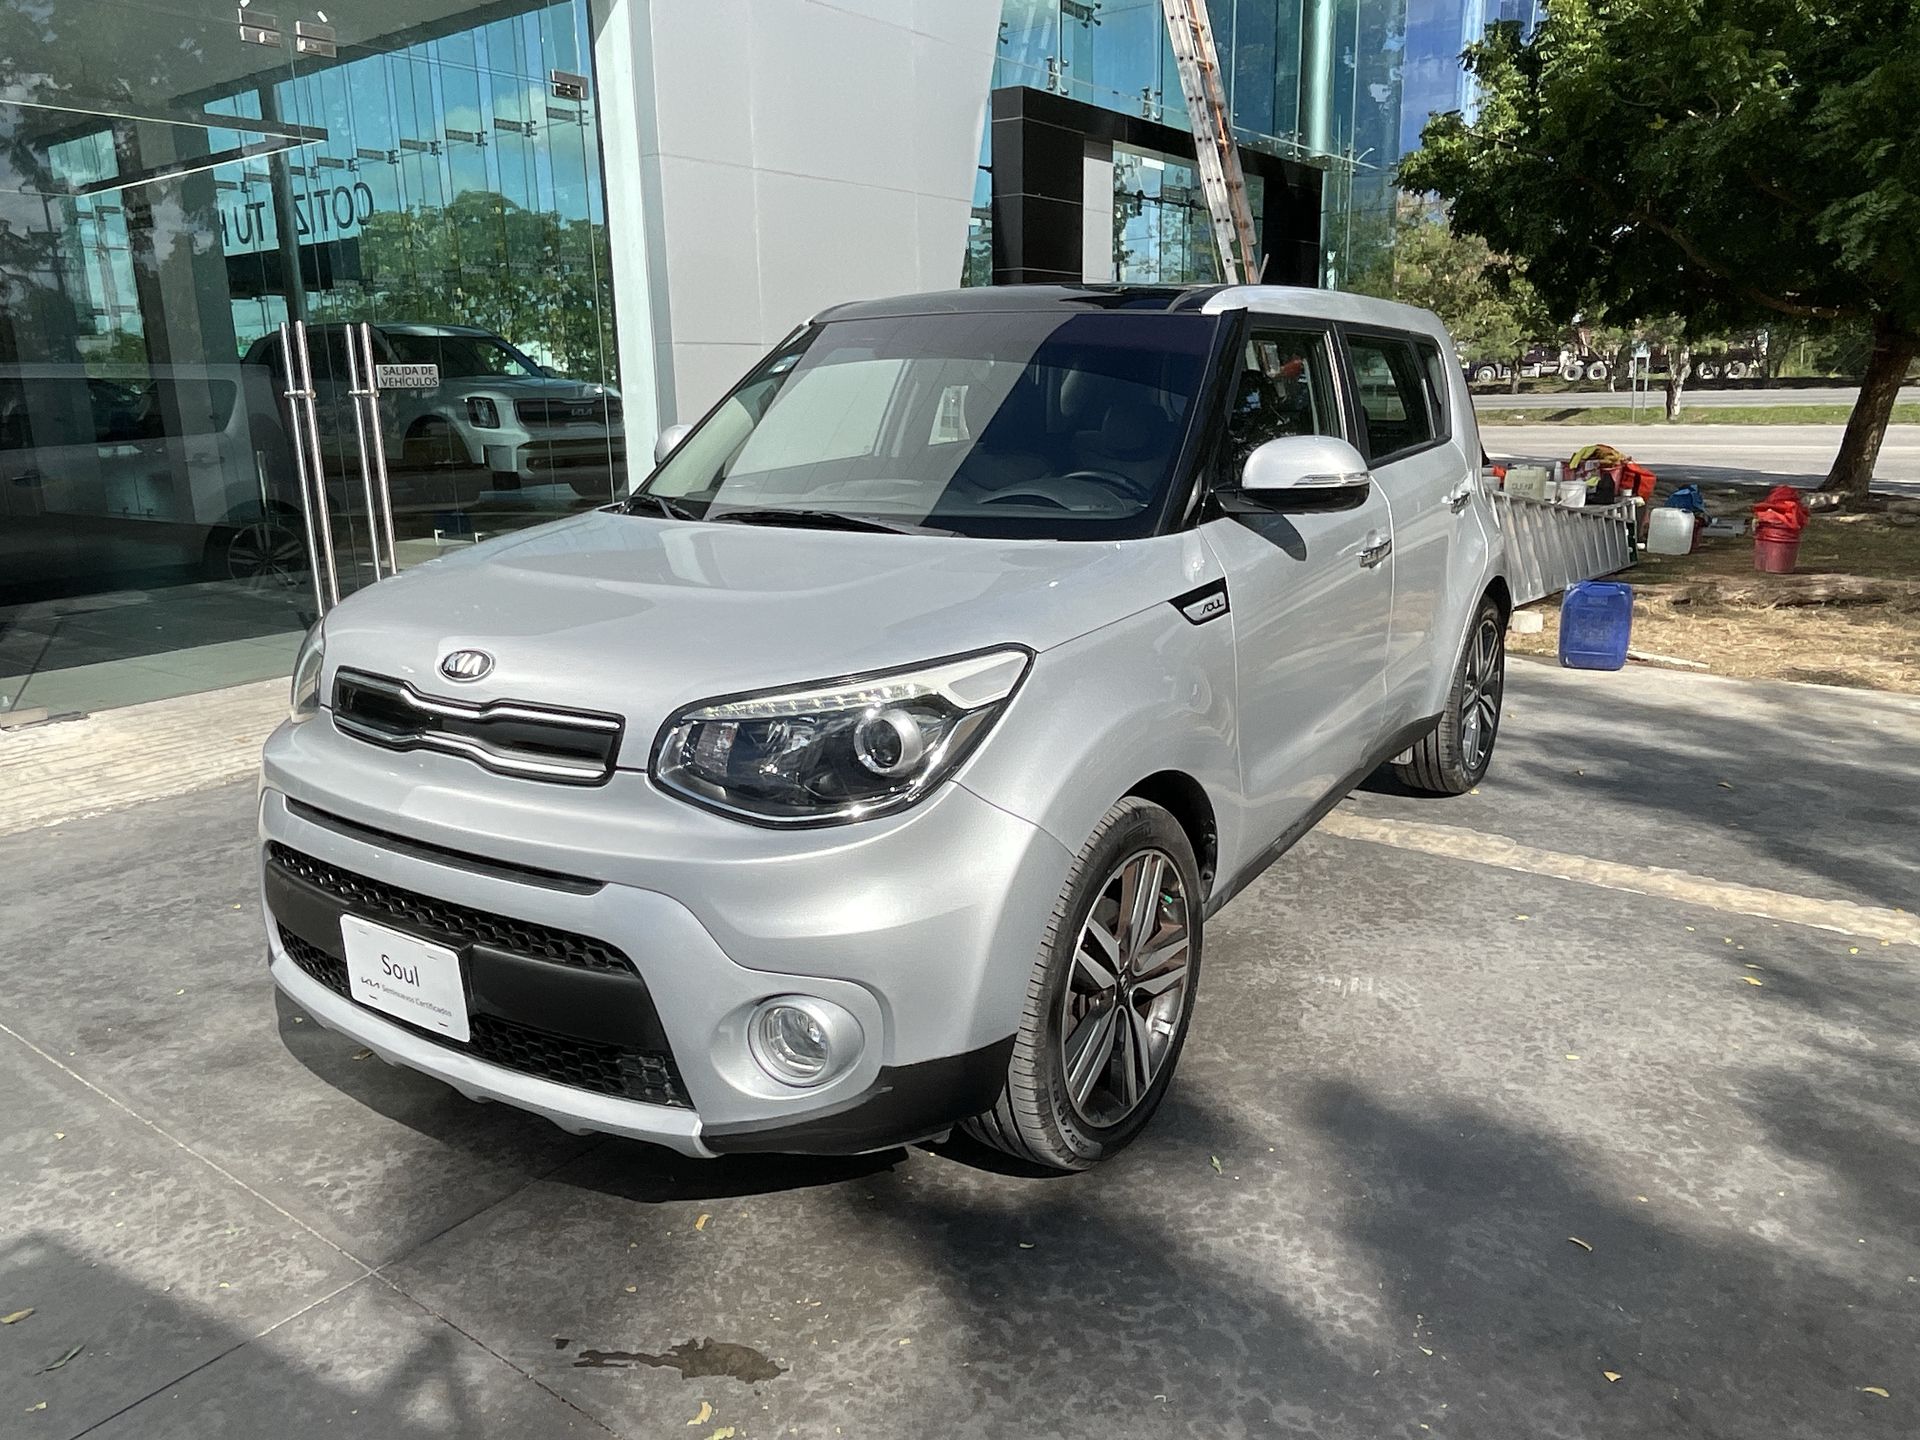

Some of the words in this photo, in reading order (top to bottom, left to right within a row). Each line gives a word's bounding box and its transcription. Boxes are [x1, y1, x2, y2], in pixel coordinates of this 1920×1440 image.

[382, 366, 419, 376] SALIDA
[421, 366, 434, 376] DE
[442, 652, 484, 675] KIA
[381, 953, 420, 987] Soul
